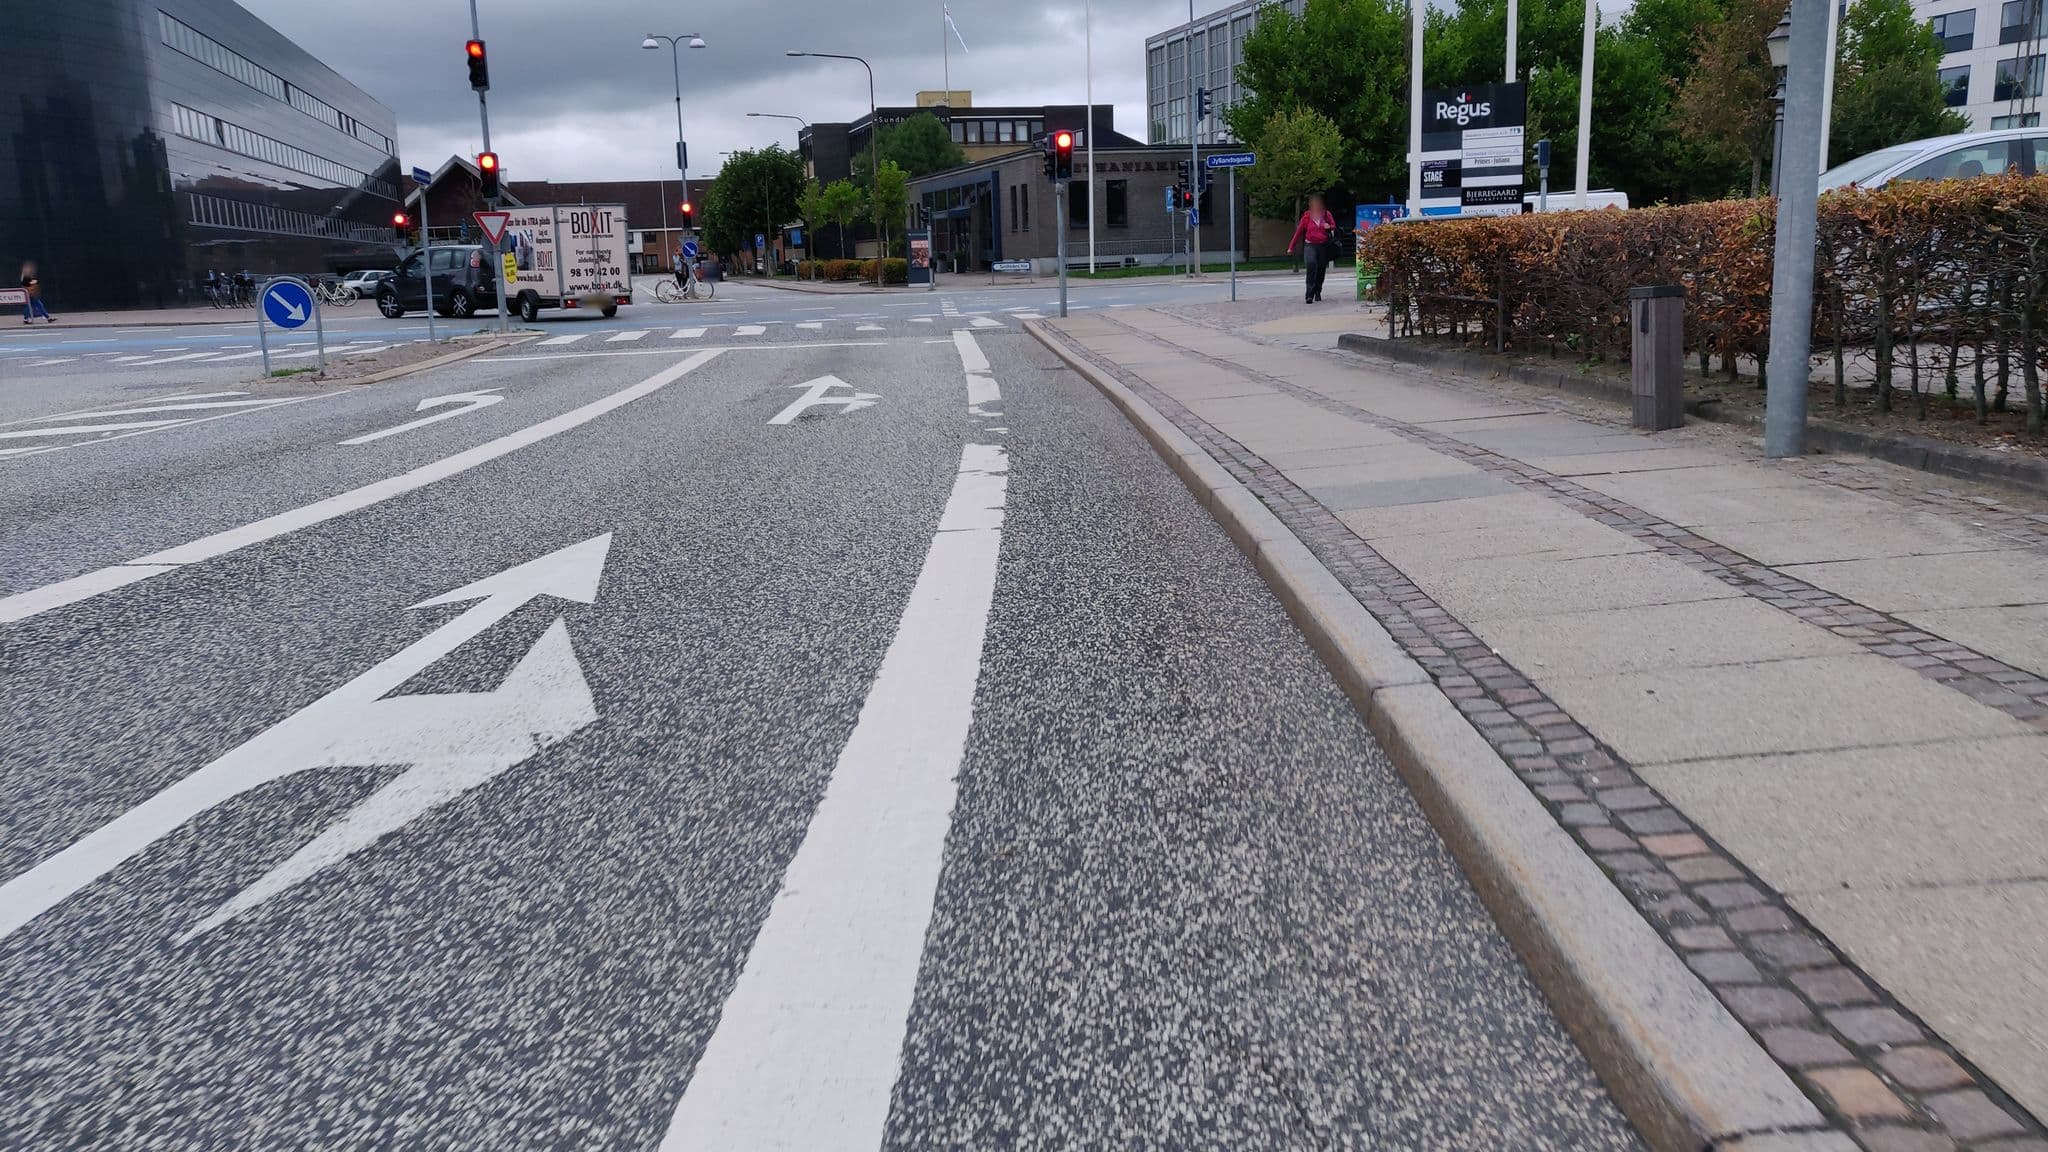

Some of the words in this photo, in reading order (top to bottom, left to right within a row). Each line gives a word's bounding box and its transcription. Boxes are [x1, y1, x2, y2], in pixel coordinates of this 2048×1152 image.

[1436, 102, 1491, 125] Regus
[1211, 156, 1252, 165] Jyllandsgade
[1423, 171, 1444, 182] STAGE
[1466, 189, 1518, 198] BJERREGAARD
[570, 212, 612, 234] BOXIT
[537, 251, 553, 267] BOXIT
[570, 268, 581, 277] 98
[584, 268, 594, 276] 19
[610, 267, 621, 275] 00
[569, 281, 623, 291] www.boxit.dk
